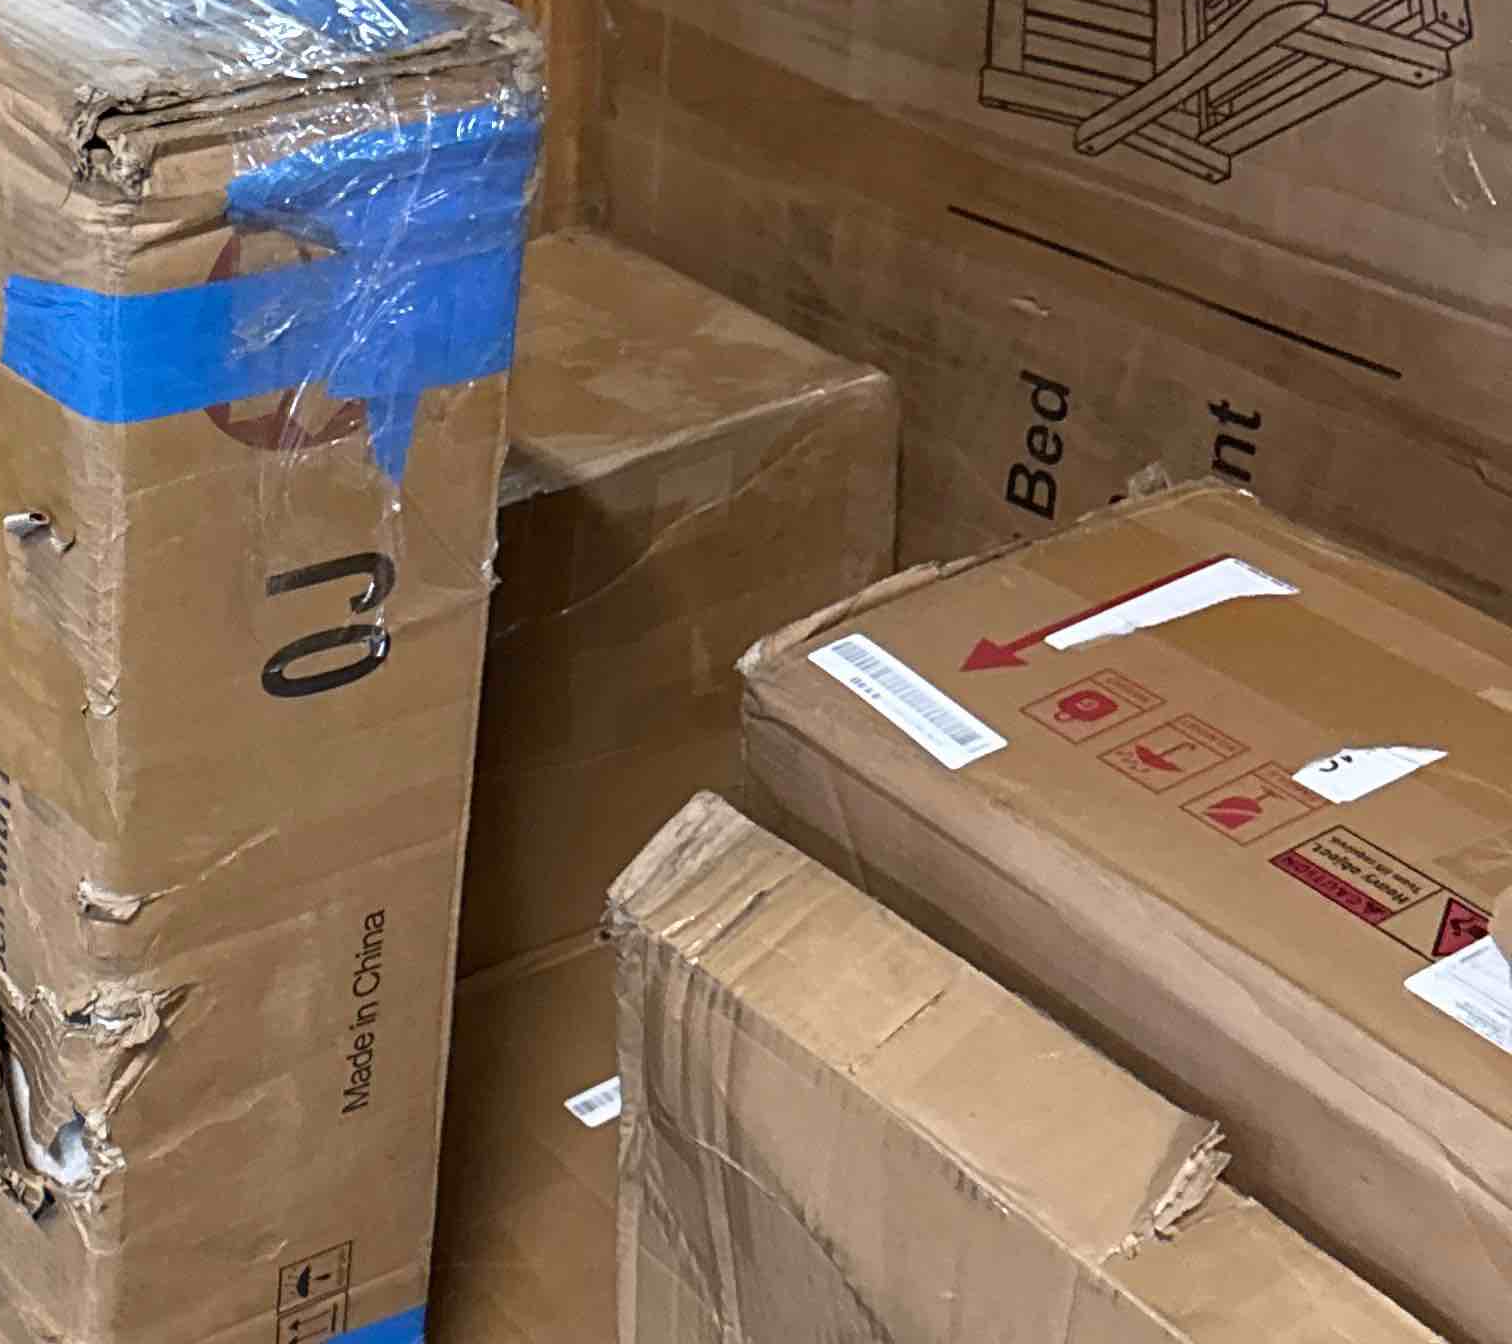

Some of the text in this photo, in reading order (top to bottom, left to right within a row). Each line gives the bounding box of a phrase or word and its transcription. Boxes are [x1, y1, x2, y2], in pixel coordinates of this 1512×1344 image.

[1005, 368, 1070, 521] Bed
[341, 908, 386, 1116] Made in China
